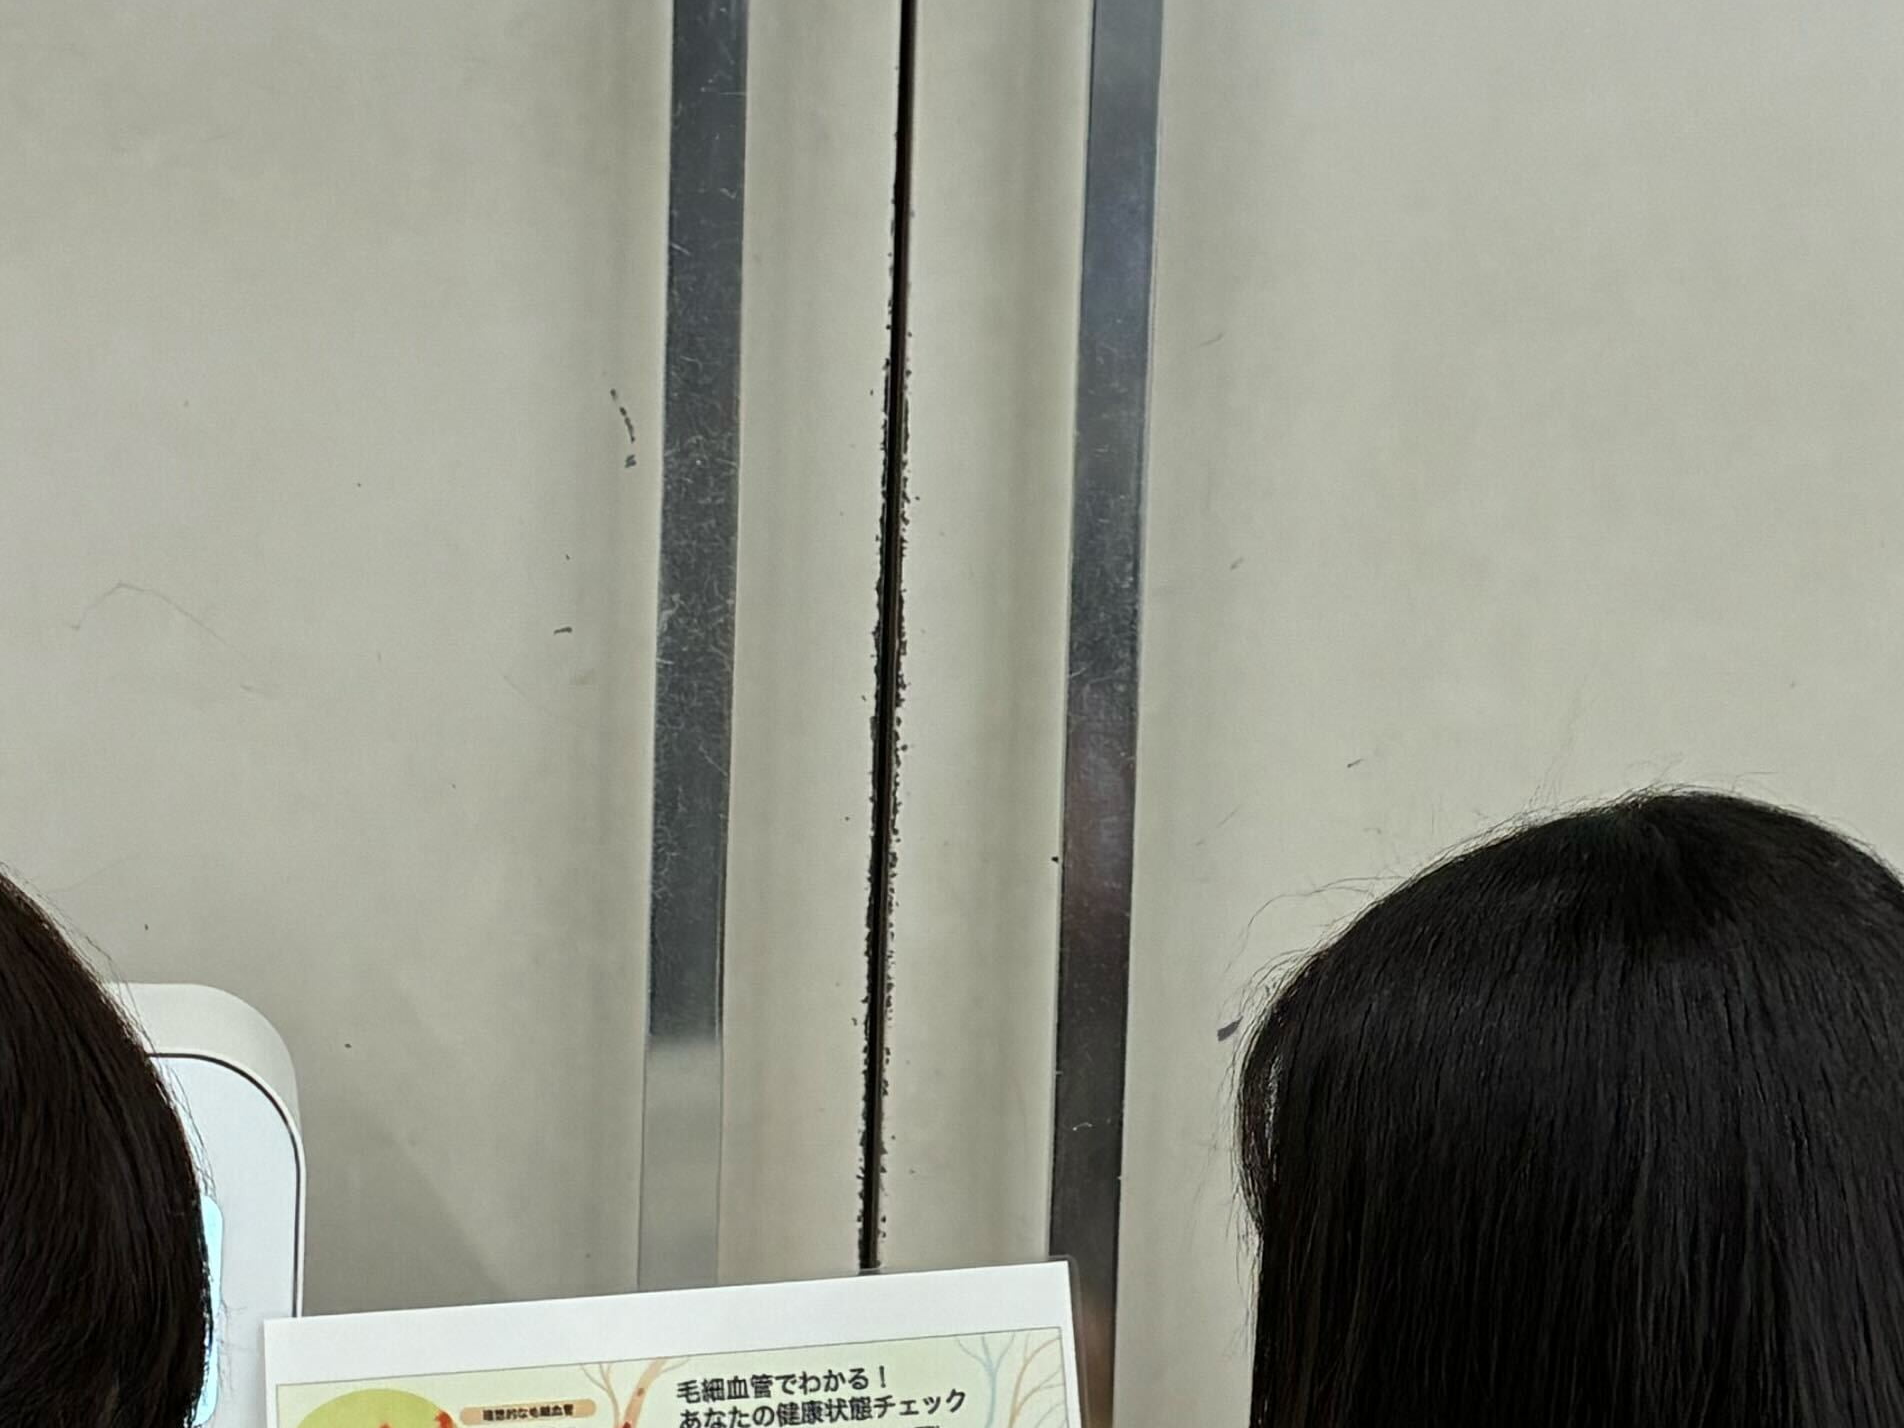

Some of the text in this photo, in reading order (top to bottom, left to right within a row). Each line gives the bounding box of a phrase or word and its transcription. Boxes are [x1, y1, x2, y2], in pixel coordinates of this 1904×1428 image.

[676, 1365, 887, 1405] 毛細血管でわかる！
